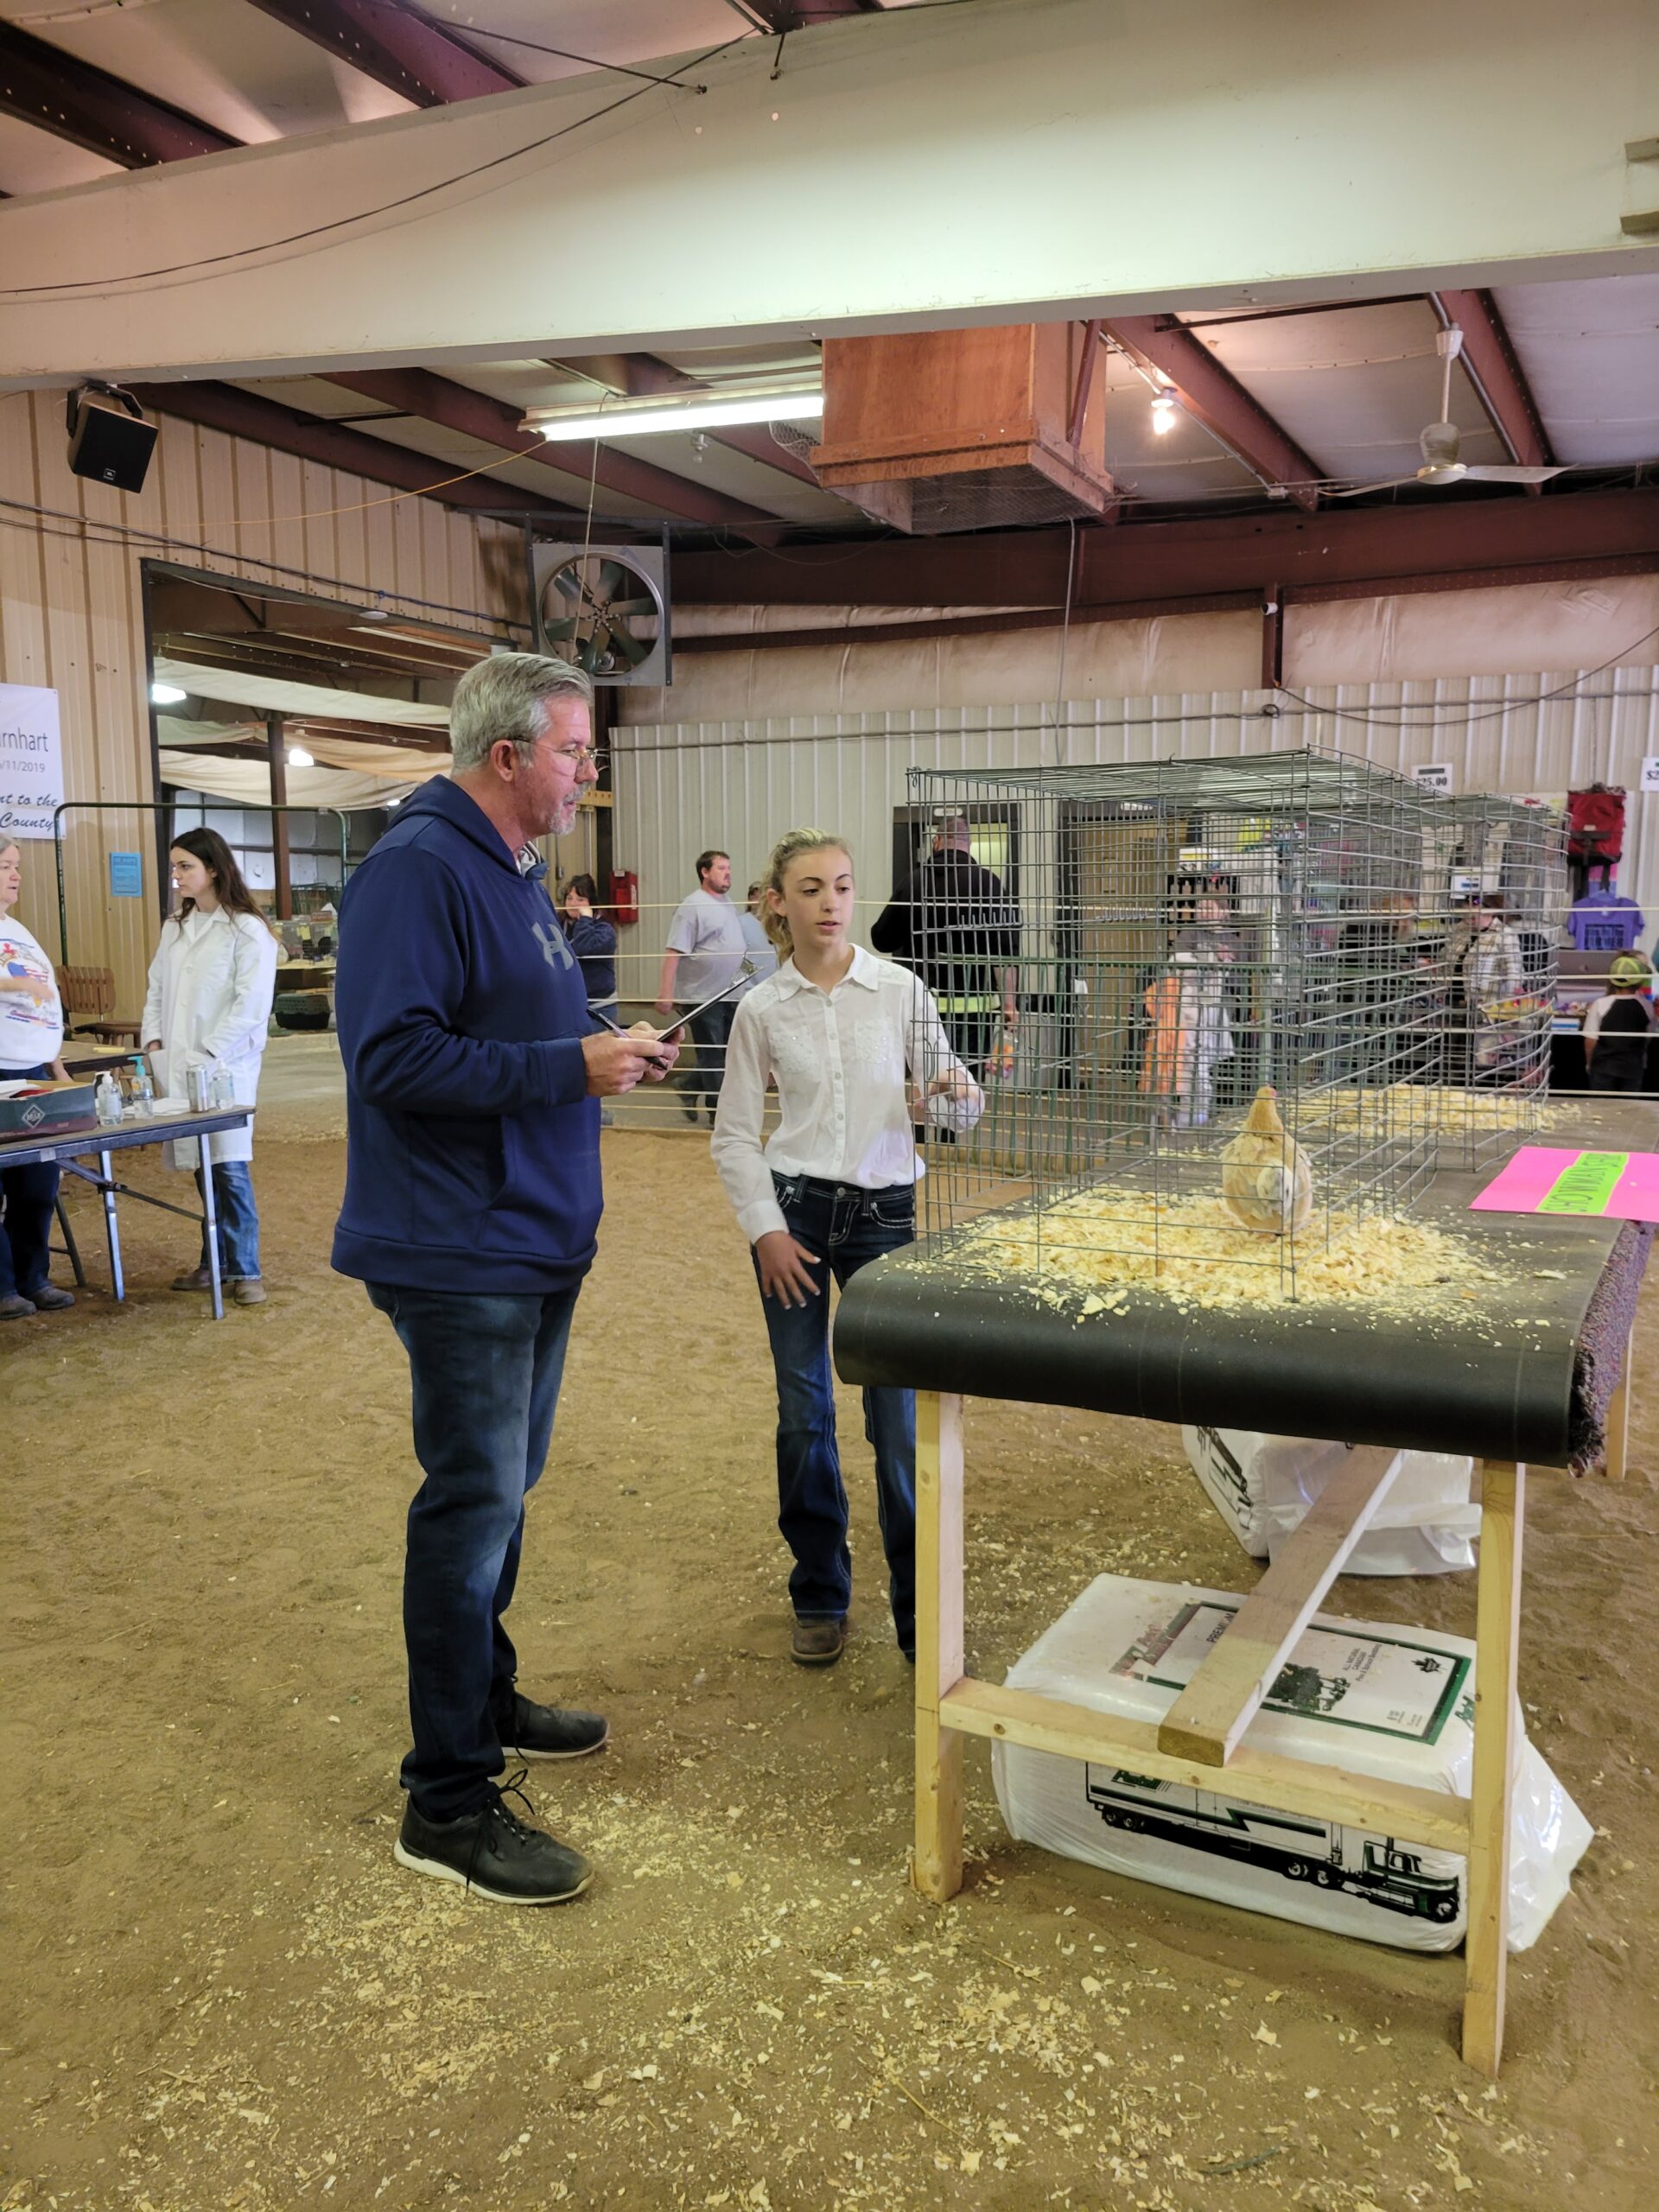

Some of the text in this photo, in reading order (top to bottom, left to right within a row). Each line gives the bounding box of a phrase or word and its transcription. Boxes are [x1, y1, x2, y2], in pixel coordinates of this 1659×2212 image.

[0, 727, 48, 753] rnhart
[0, 760, 46, 773] /11/2019
[17, 794, 31, 805] to
[36, 794, 58, 807] the
[0, 812, 54, 832] County
